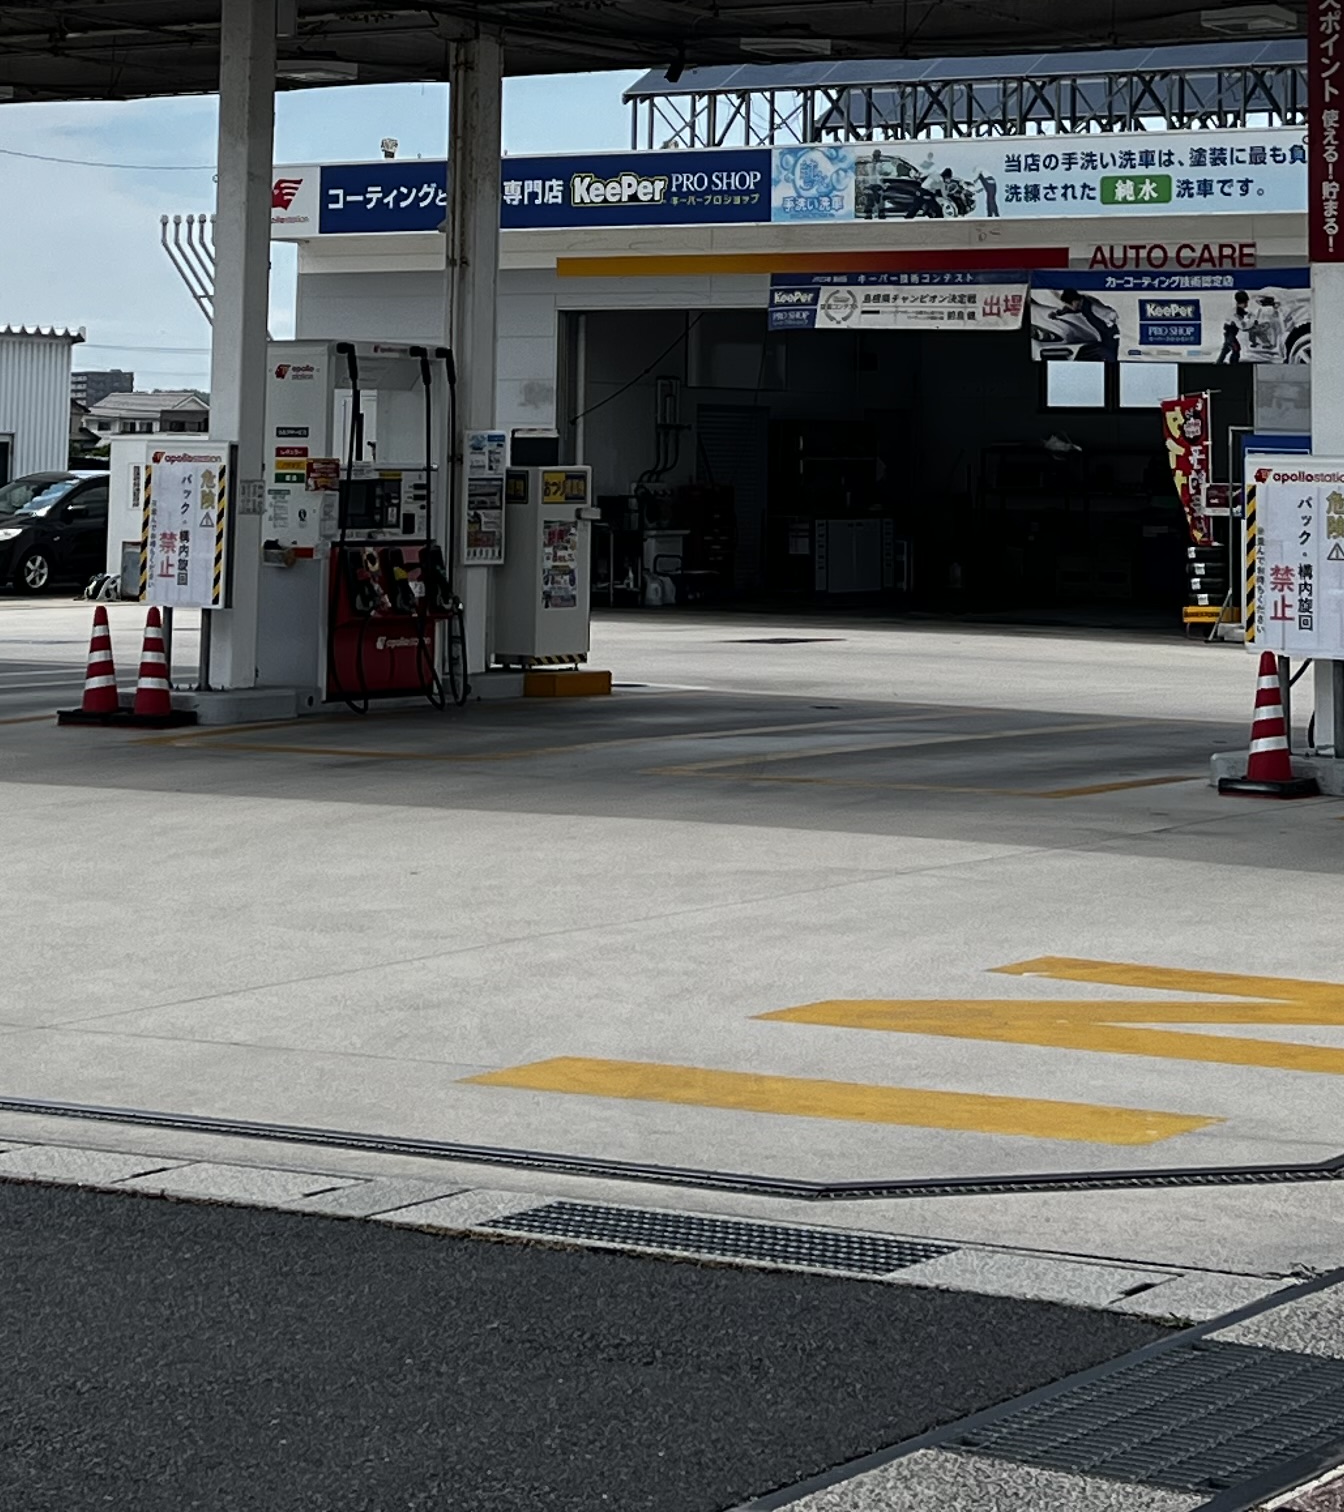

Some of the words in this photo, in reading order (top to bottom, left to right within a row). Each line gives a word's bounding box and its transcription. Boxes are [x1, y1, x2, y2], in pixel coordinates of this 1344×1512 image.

[572, 174, 667, 205] KeePer
[670, 172, 708, 193] PRO
[711, 170, 761, 192] SHOP
[1005, 180, 1097, 203] 洗練された
[1114, 177, 1160, 202] 純水
[1176, 178, 1265, 199] 洗車です。
[782, 195, 844, 213] 手洗い洗車
[1089, 244, 1168, 269] AUTO
[1175, 244, 1256, 268] CARE
[1104, 274, 1235, 289] カーコーティング技術認定店
[774, 290, 815, 305] KeePer
[982, 294, 1023, 317] 出場
[1145, 302, 1195, 318] KeePer
[1148, 326, 1168, 336] PRO
[1169, 325, 1195, 336] SHOP
[156, 531, 178, 578] 禁止
[1269, 564, 1296, 622] 禁止
